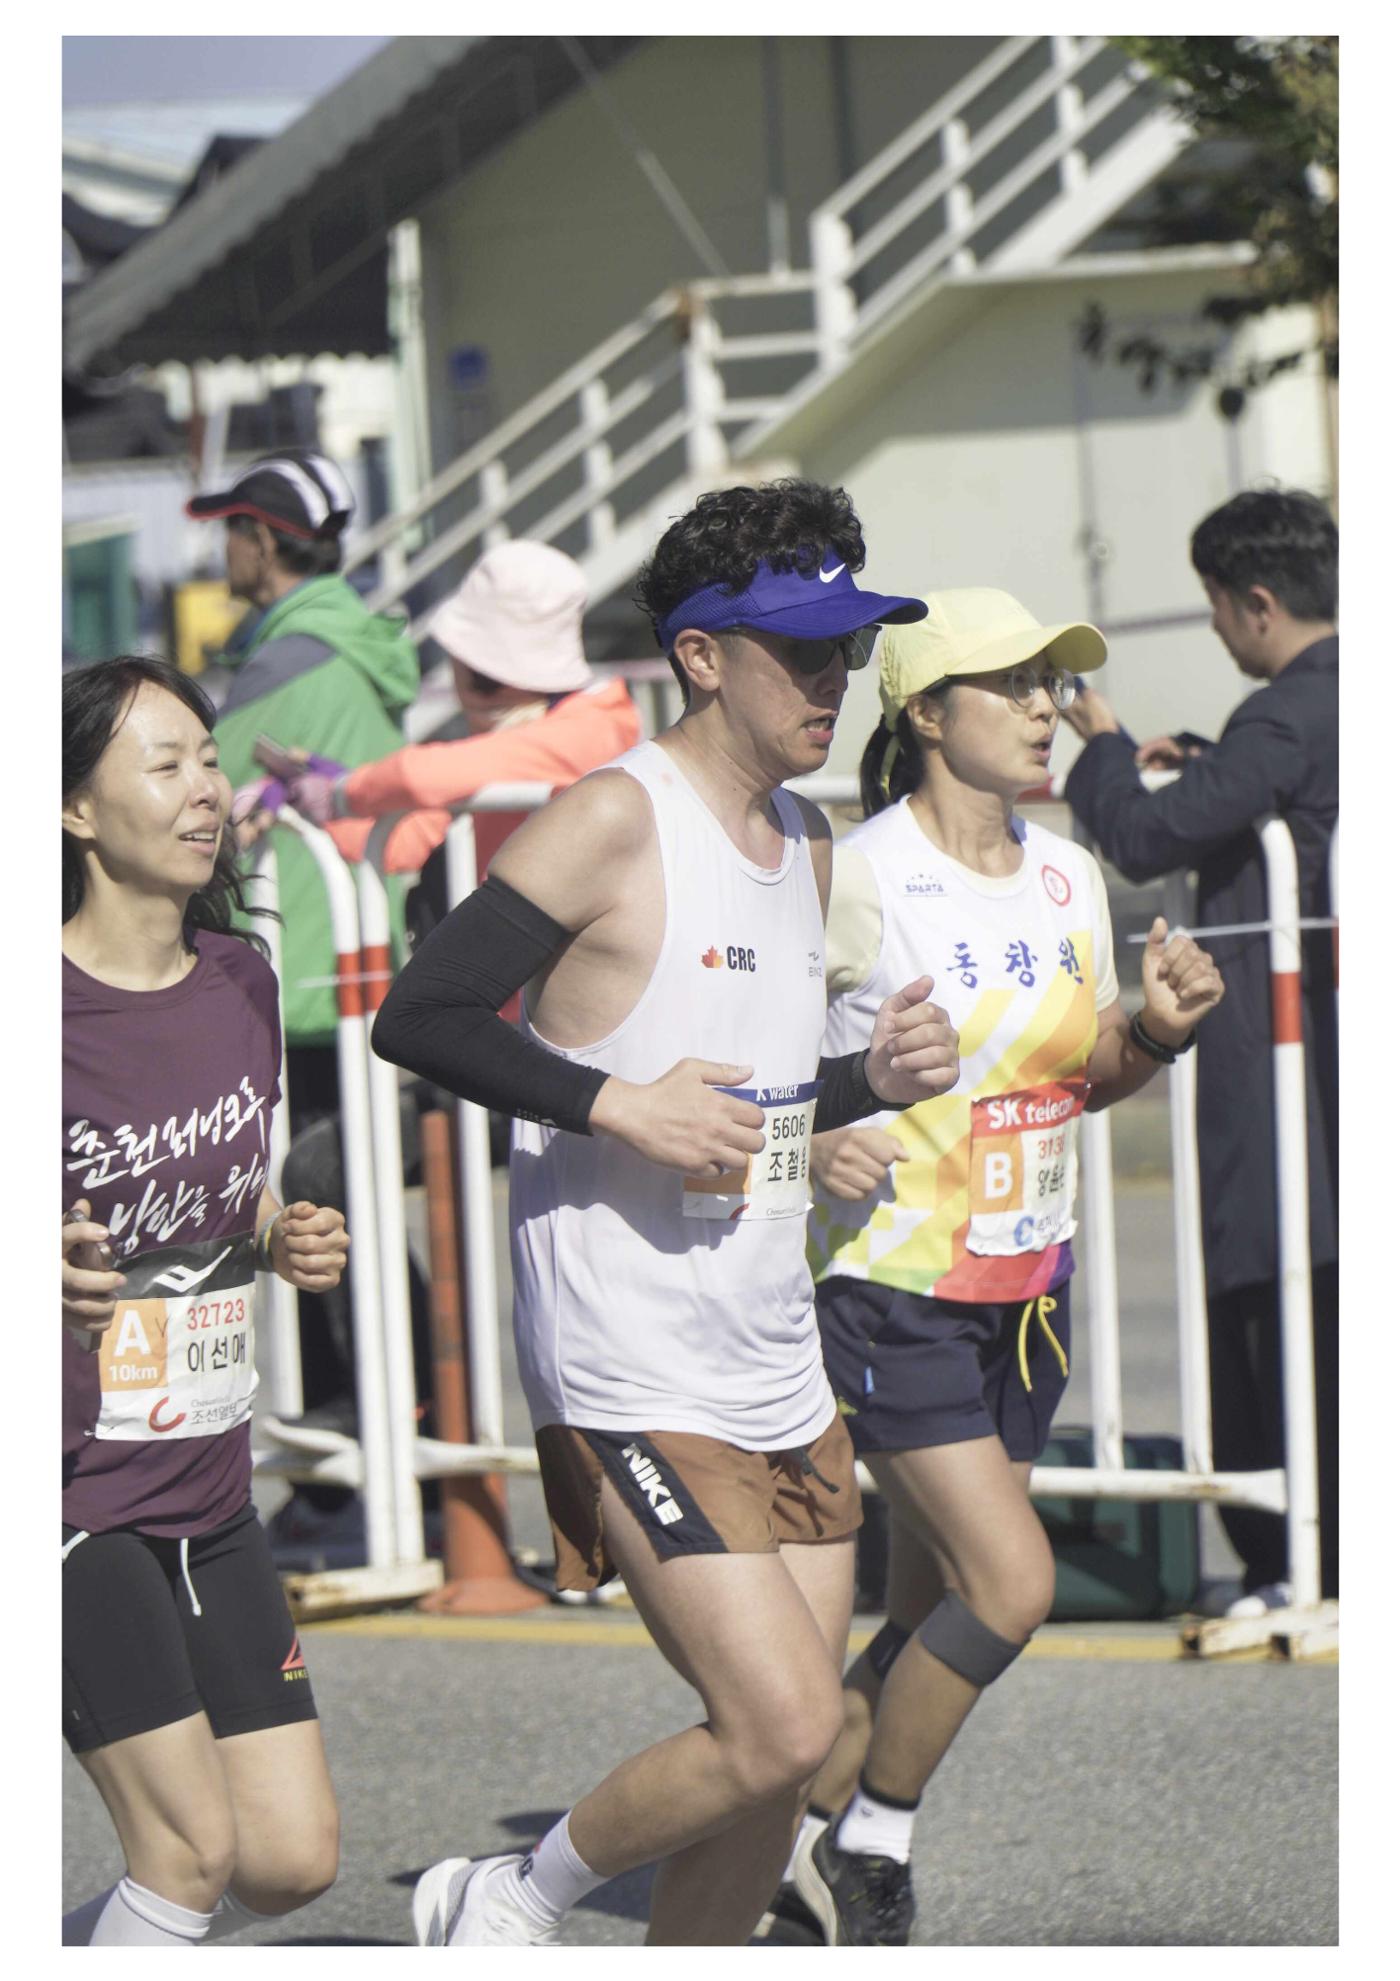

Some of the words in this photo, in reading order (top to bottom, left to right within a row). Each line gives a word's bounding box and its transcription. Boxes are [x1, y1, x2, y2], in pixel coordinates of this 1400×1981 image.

[726, 945, 757, 973] CRC
[769, 1081, 799, 1101] water
[772, 1114, 806, 1140] 5606
[987, 1097, 1024, 1130] SK
[984, 1151, 1014, 1200] B
[186, 1298, 246, 1331] 32723
[113, 1309, 152, 1358] A
[108, 1363, 158, 1383] 10km
[621, 1442, 684, 1526] NIKE
